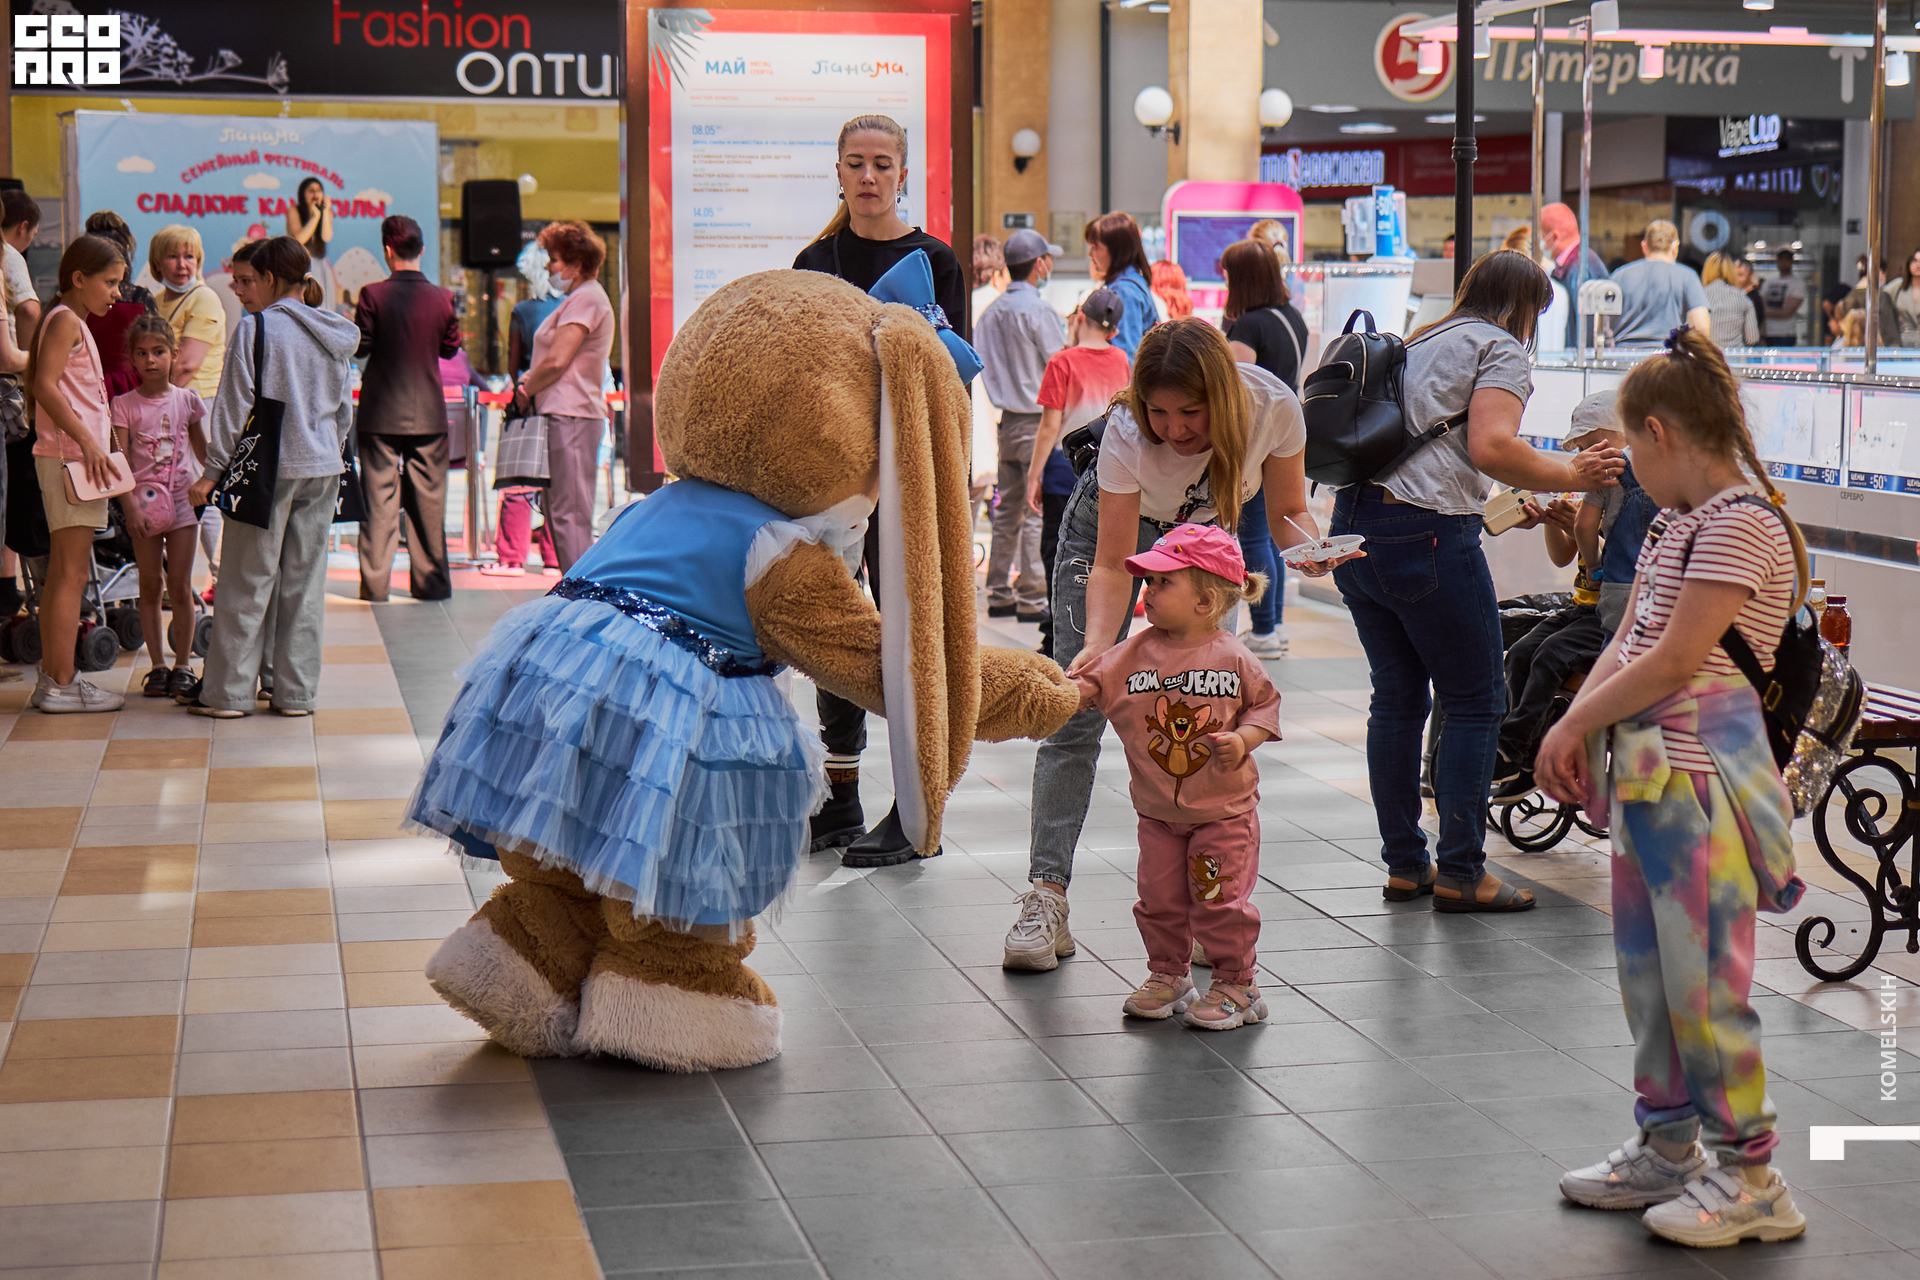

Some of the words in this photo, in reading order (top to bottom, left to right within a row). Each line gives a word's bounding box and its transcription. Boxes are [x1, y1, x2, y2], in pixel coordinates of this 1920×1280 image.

[456, 51, 619, 97] ОПТИ
[705, 57, 746, 74] МАЙ
[692, 125, 715, 136] 08.05
[180, 149, 260, 184] СЕМЕЙНЫЙ
[263, 153, 345, 190] ФЕСТИВАЛЬ
[137, 193, 249, 218] СЛАДКИЕ
[693, 207, 714, 217] 14.05
[694, 269, 717, 280] 22.05
[211, 489, 242, 513] FLY
[1840, 491, 1865, 502] СЕРЕБРО
[1125, 669, 1161, 695] TOM
[1162, 673, 1185, 691] and
[1180, 669, 1240, 699] JERRY
